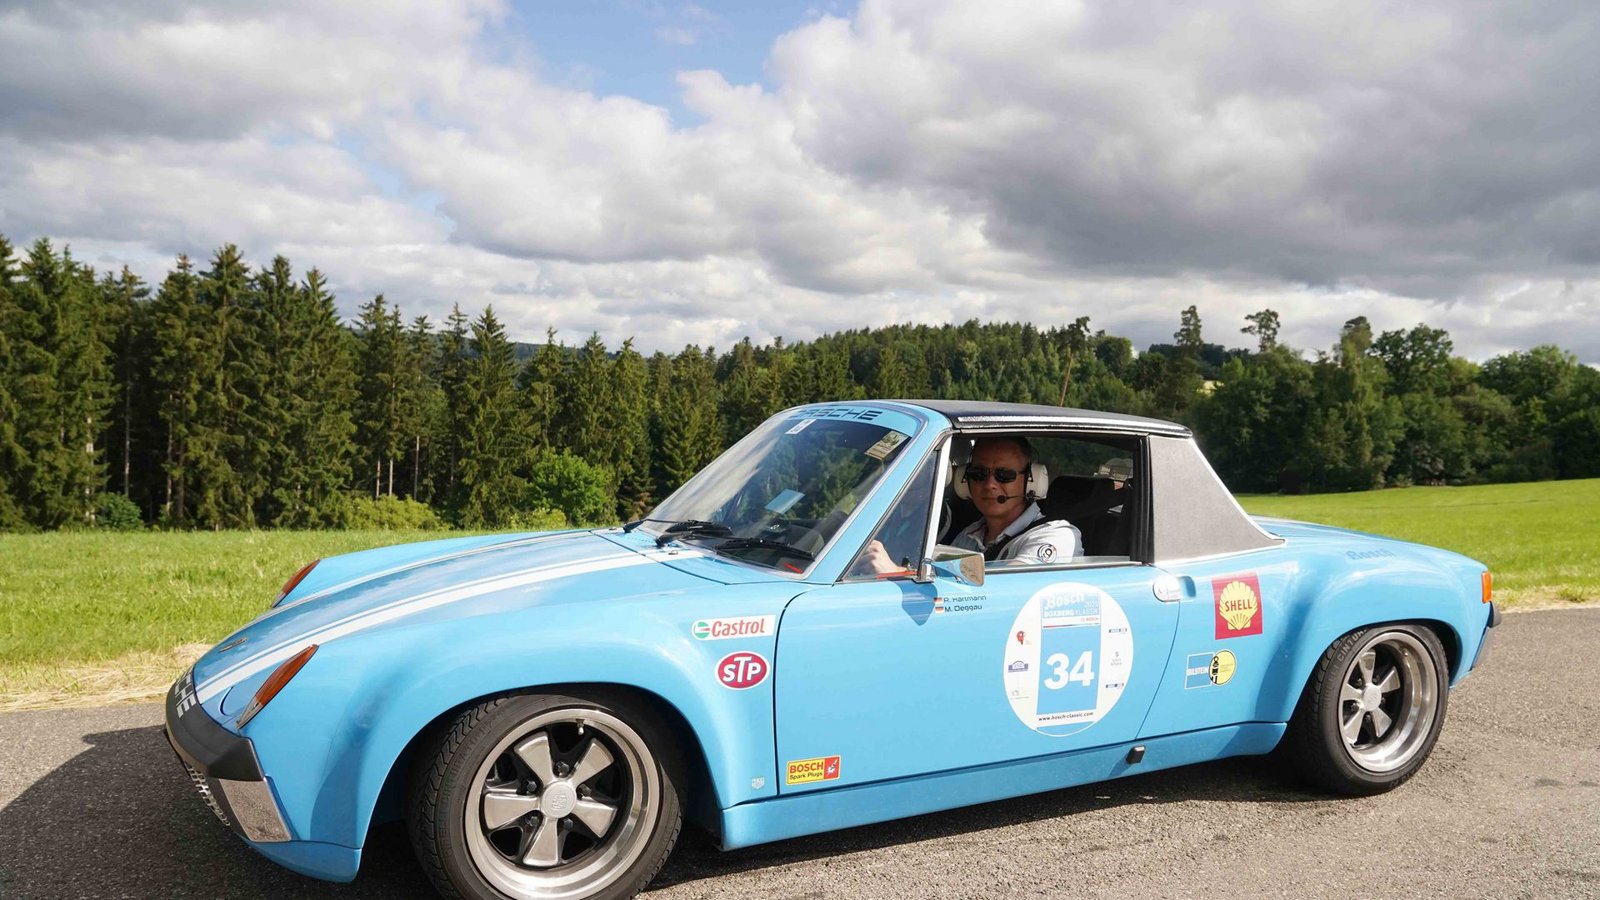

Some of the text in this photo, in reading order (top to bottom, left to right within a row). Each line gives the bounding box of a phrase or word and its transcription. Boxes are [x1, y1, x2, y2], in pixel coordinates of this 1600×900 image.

[1224, 599, 1253, 612] SHELL
[711, 618, 765, 637] Castrol
[722, 656, 762, 683] STP
[1044, 650, 1095, 690] 34
[789, 762, 824, 774] BOSCH
